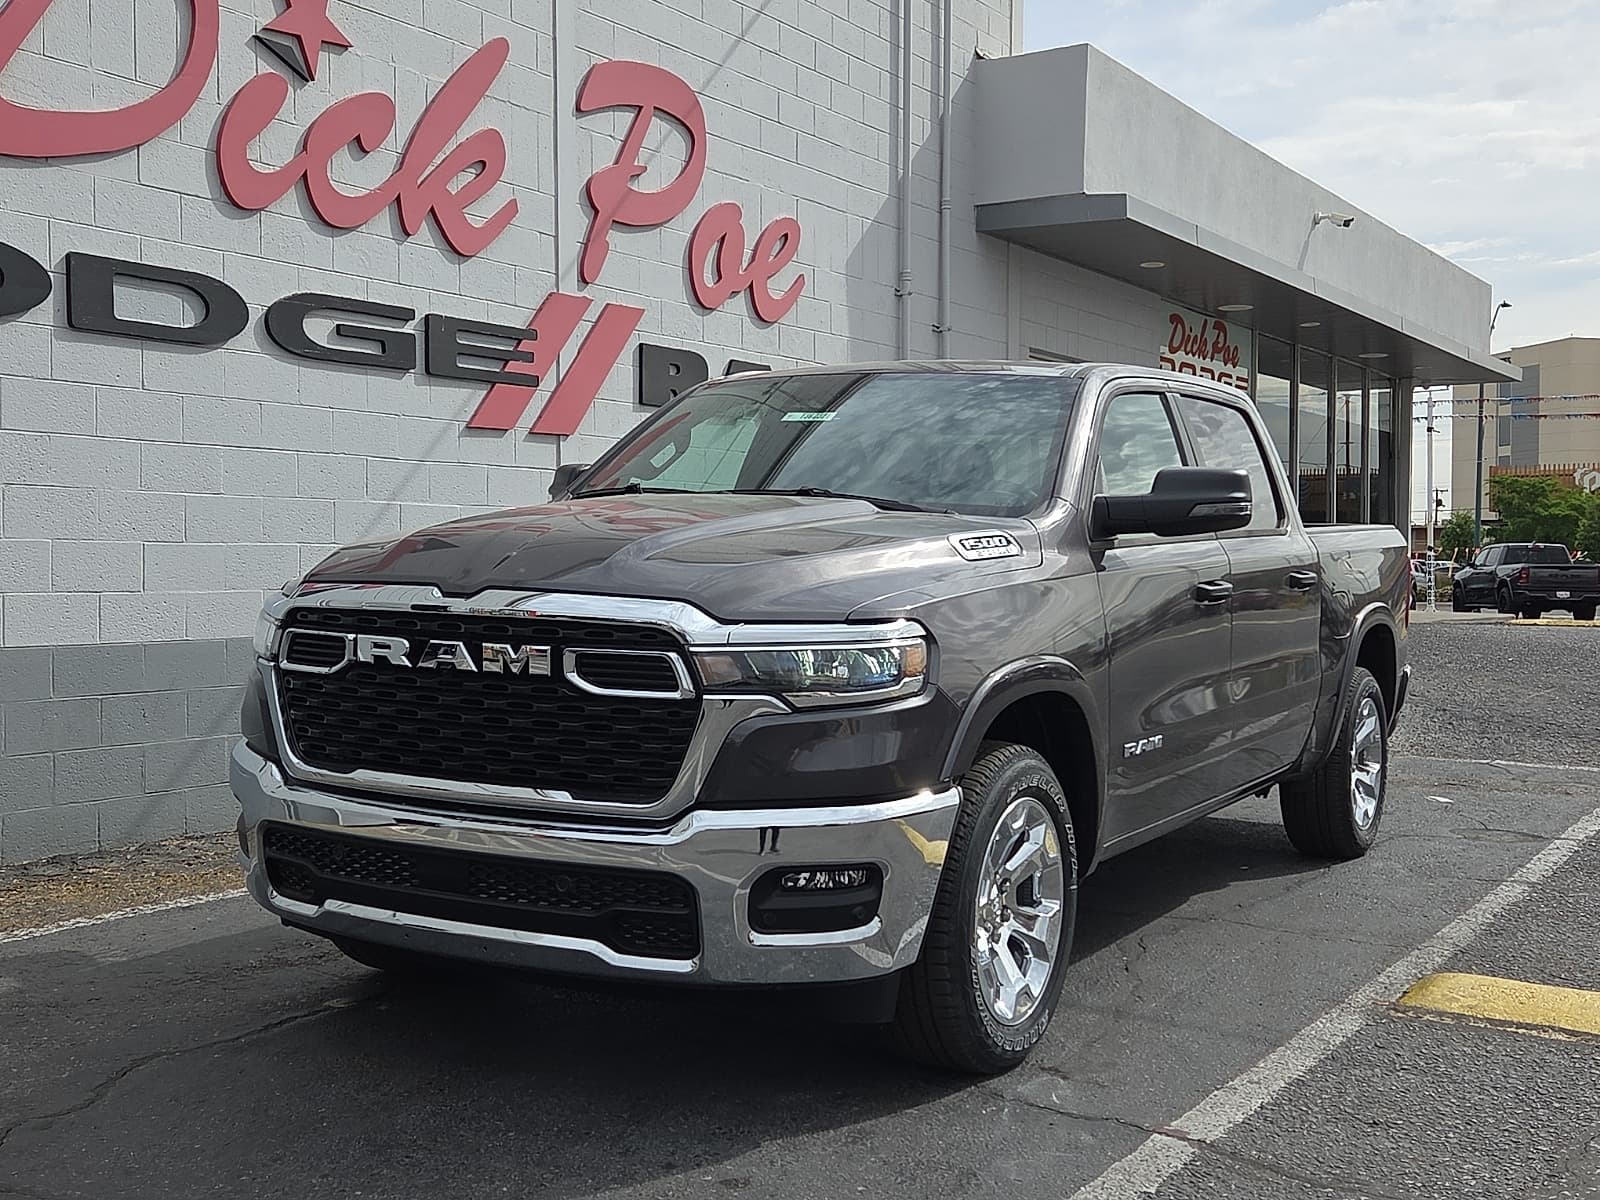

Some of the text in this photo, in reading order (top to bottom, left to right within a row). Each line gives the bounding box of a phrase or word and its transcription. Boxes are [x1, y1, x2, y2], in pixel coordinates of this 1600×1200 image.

[576, 59, 806, 324] Poe
[0, 242, 540, 388] DGE
[1168, 312, 1240, 369] Dick Poe
[960, 536, 1009, 550] 1500
[356, 634, 552, 676] RAM
[1123, 734, 1163, 758] RAM
